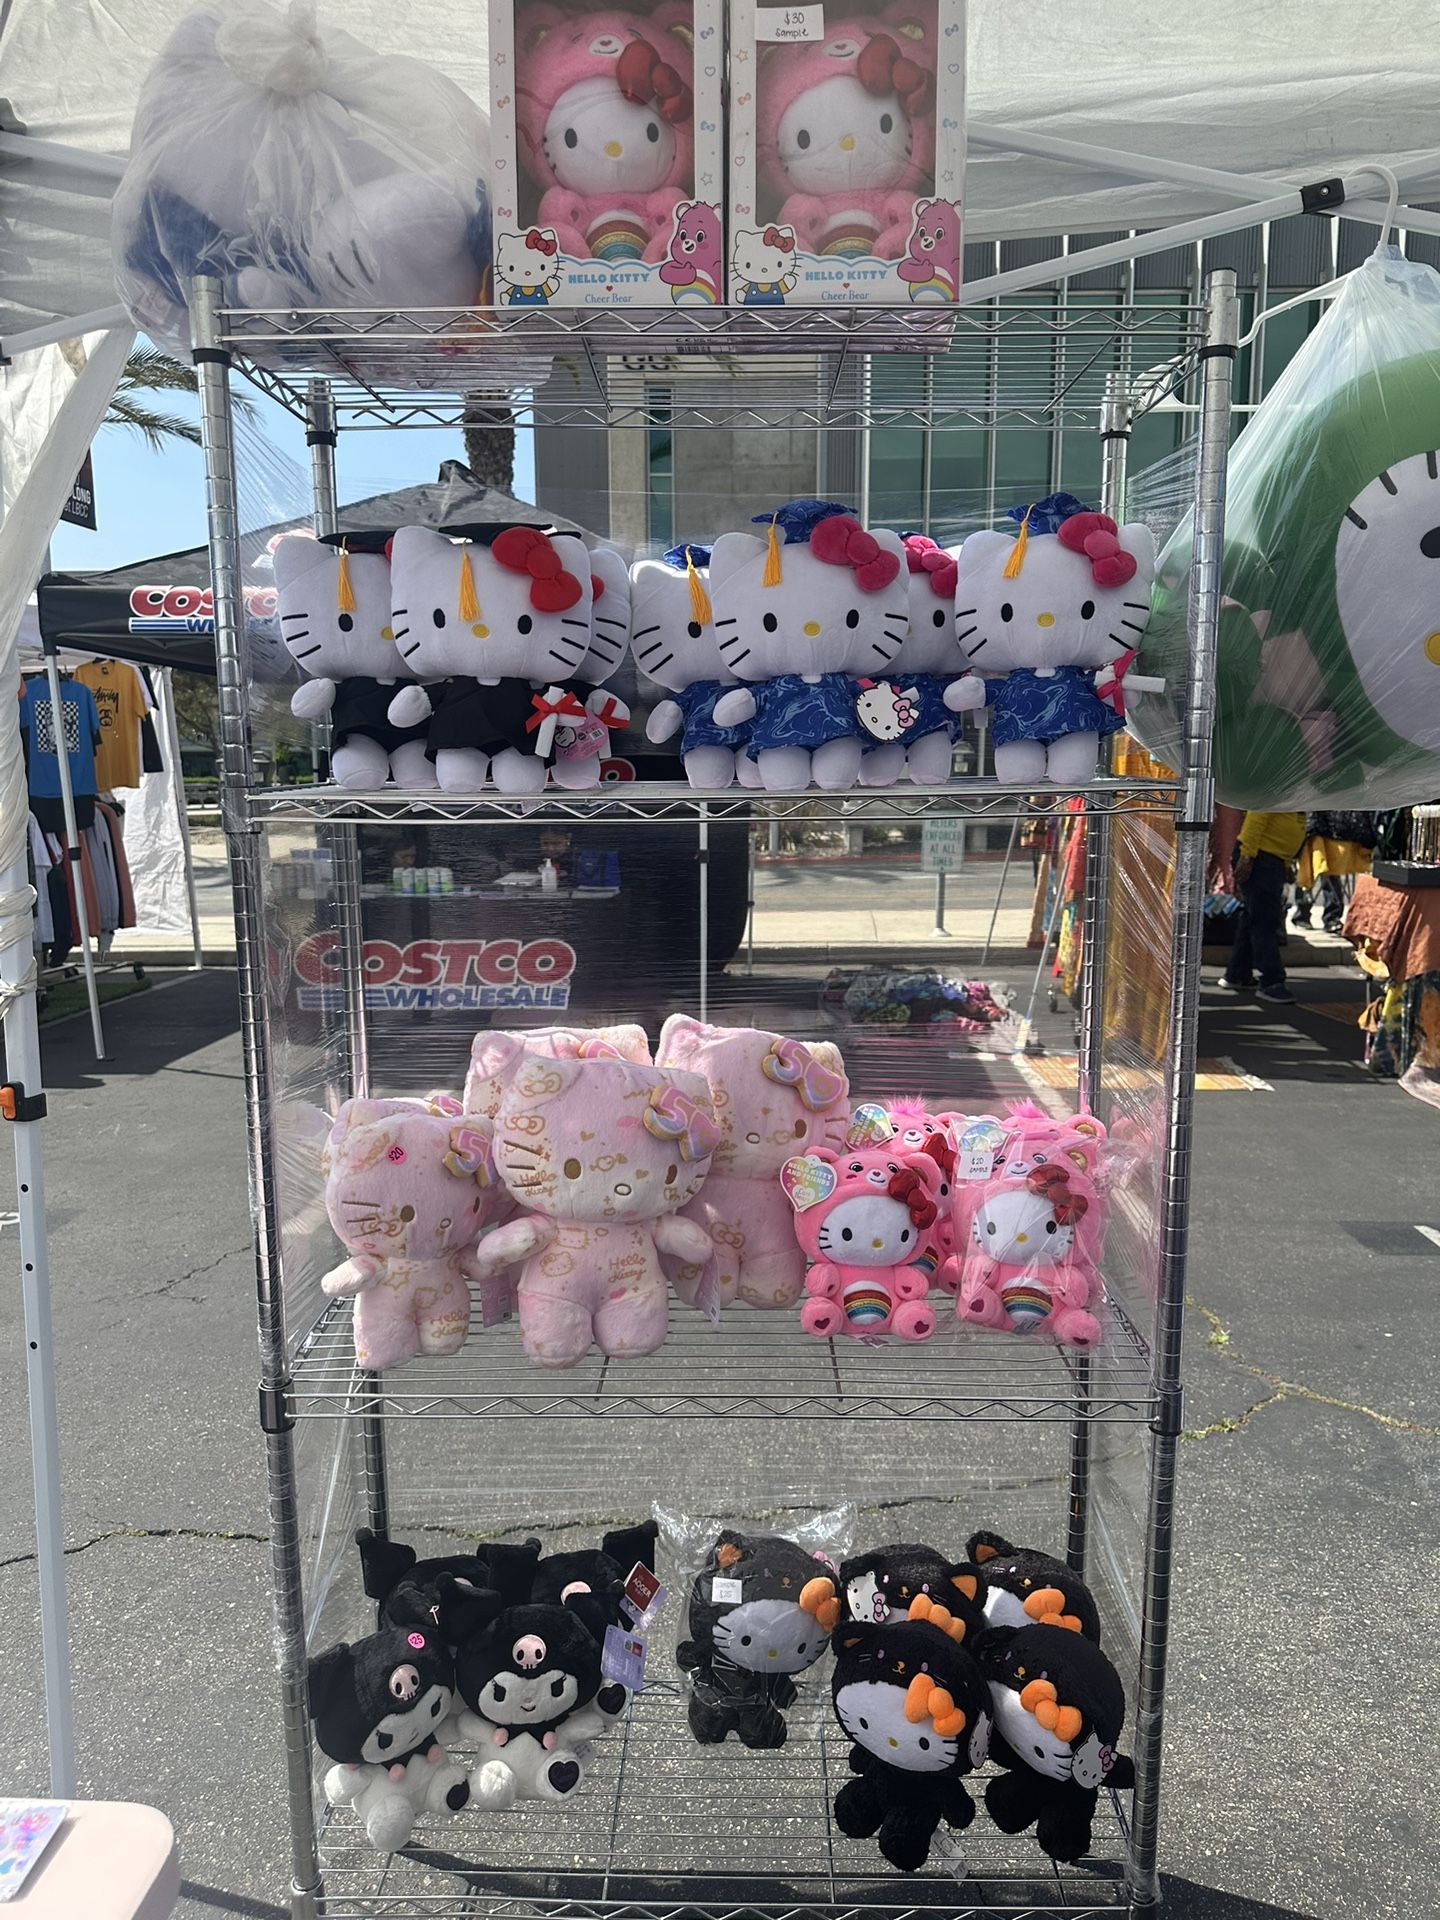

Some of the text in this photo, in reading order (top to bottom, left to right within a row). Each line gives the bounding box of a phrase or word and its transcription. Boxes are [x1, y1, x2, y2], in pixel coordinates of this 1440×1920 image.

[784, 10, 804, 25] $30
[568, 273, 650, 284] HELLO KITTY
[805, 270, 887, 280] HELLO KITTY
[585, 293, 632, 304] Cheer Bear
[821, 290, 870, 300] Cheer Bear
[293, 931, 577, 986] COSTCO
[384, 986, 570, 1009] WHOLESALE
[388, 1146, 404, 1161] $20
[608, 1253, 647, 1270] Hello
[608, 1269, 647, 1283] Kitty
